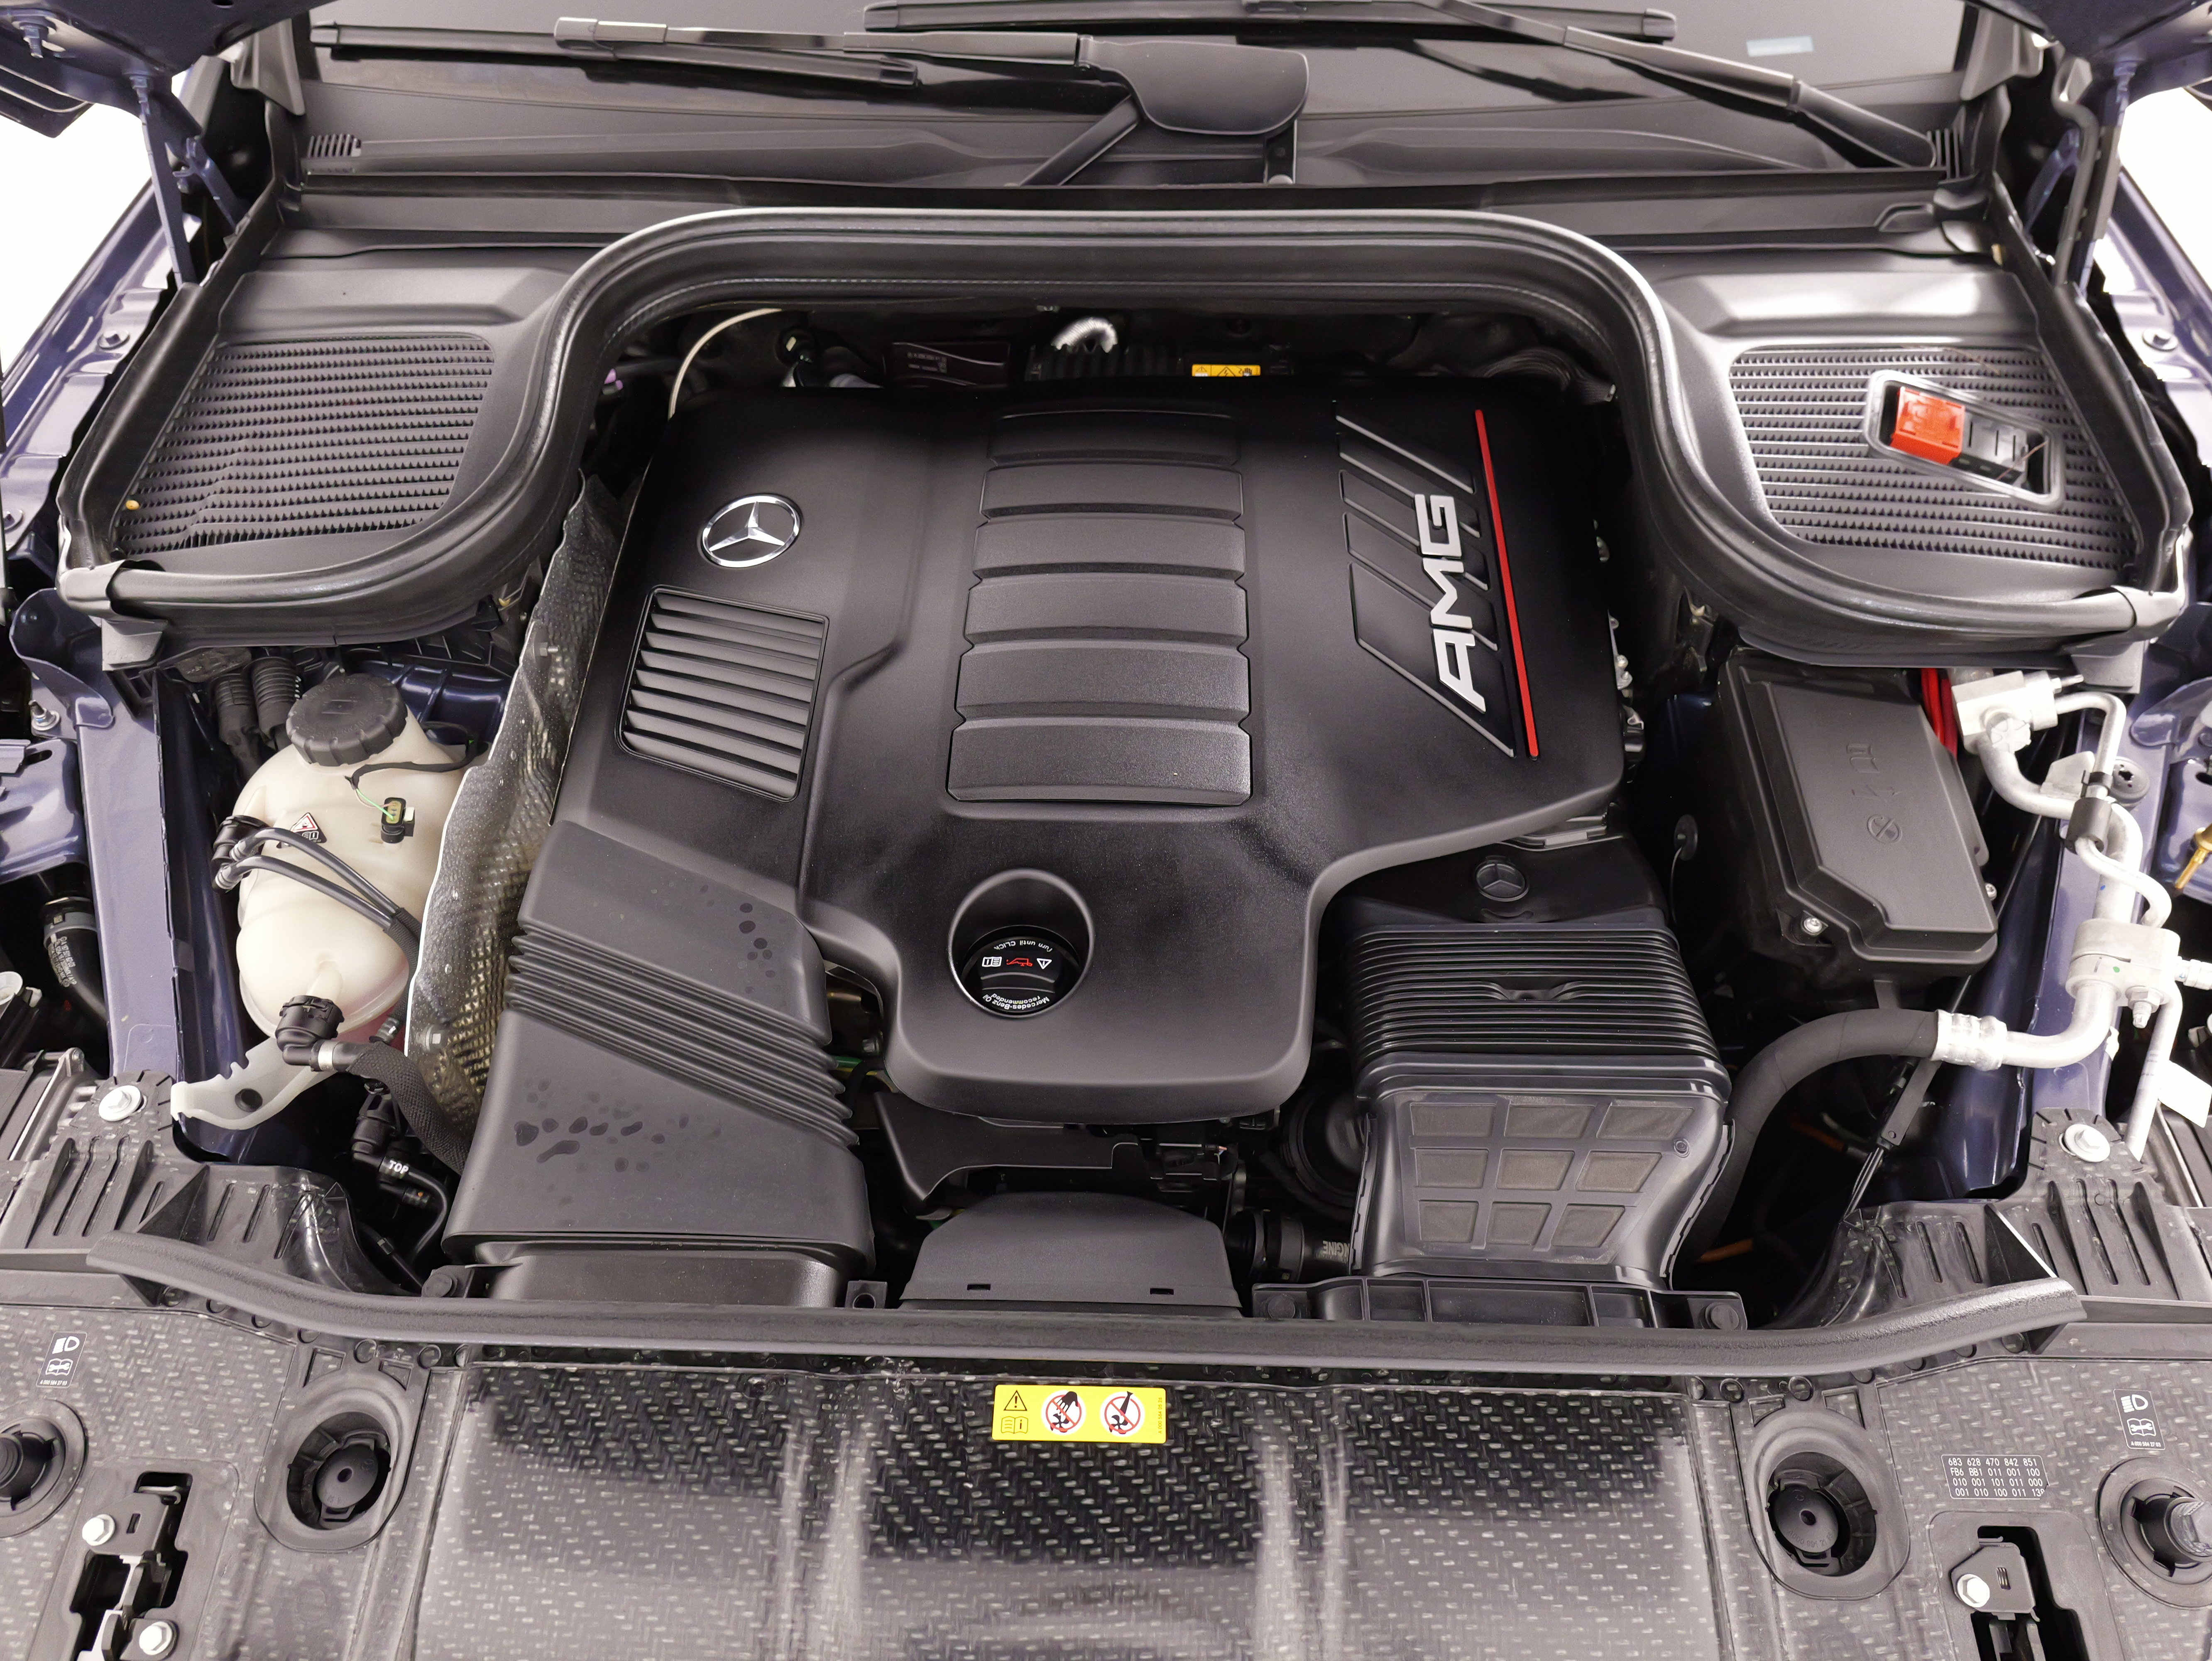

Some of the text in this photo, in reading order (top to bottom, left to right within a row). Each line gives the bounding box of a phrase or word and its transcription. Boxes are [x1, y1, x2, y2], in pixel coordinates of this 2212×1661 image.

[1414, 494, 1486, 713] AMG
[993, 941, 1016, 950] CLICK
[1038, 943, 1053, 953] Turn
[982, 994, 1050, 1010] Mercedes-Benz Oil
[991, 993, 1040, 1004] recommended
[389, 1160, 409, 1174] TOP
[1322, 1240, 1349, 1257] NGINE
[1948, 1458, 2037, 1466] 683 628 470 842 851
[1950, 1468, 2041, 1477] FB6 BB1 011 001 100
[1953, 1478, 2043, 1487] 010 001 101 011 000
[1955, 1488, 1970, 1497] 001
[1974, 1488, 1989, 1497] 010
[1994, 1488, 2008, 1497] 100
[2012, 1488, 2026, 1497] 011
